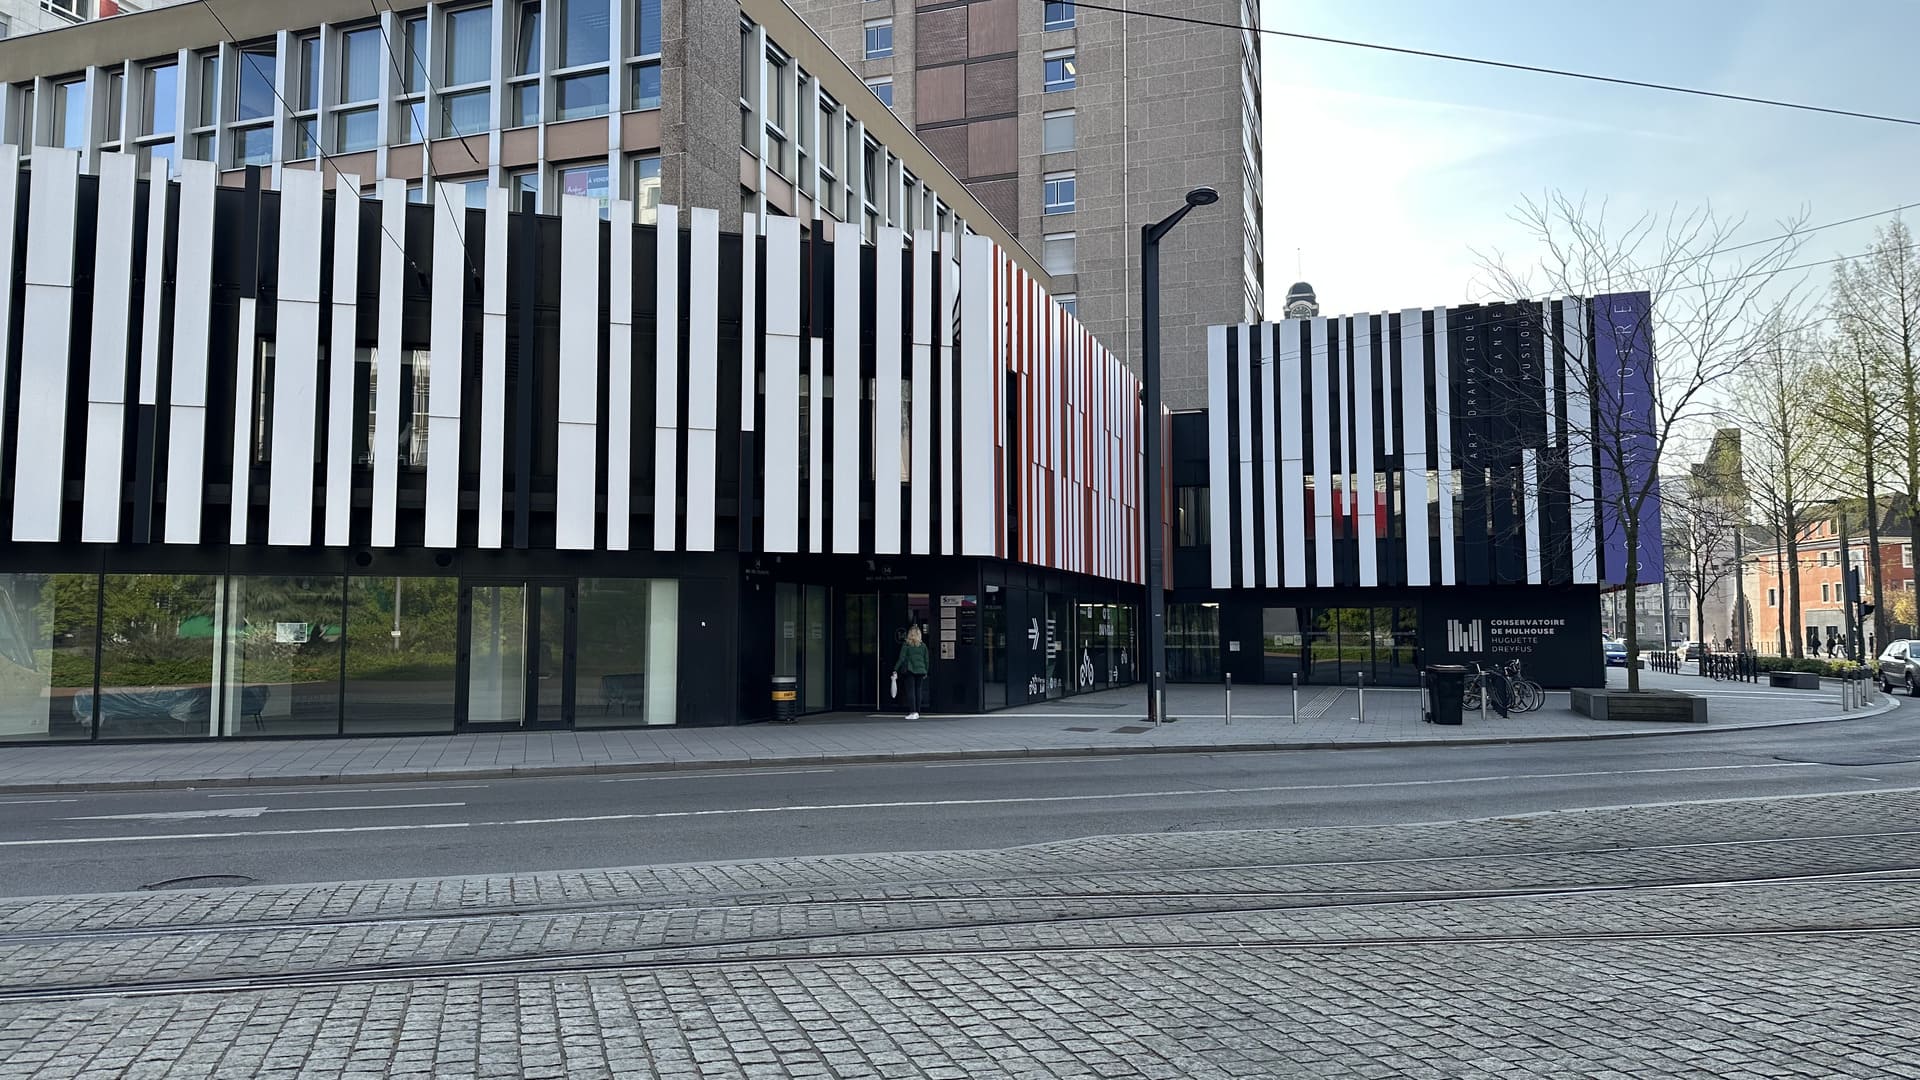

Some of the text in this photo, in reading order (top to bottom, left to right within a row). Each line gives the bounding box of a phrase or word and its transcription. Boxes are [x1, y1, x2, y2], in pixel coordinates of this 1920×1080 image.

[1493, 312, 1503, 374] DANSE
[1520, 311, 1531, 380] MUSIQUE
[1465, 315, 1478, 459] ART DRAMATIQUE
[1491, 636, 1538, 644] HUGUETTE
[1491, 645, 1533, 653] DREYFUS
